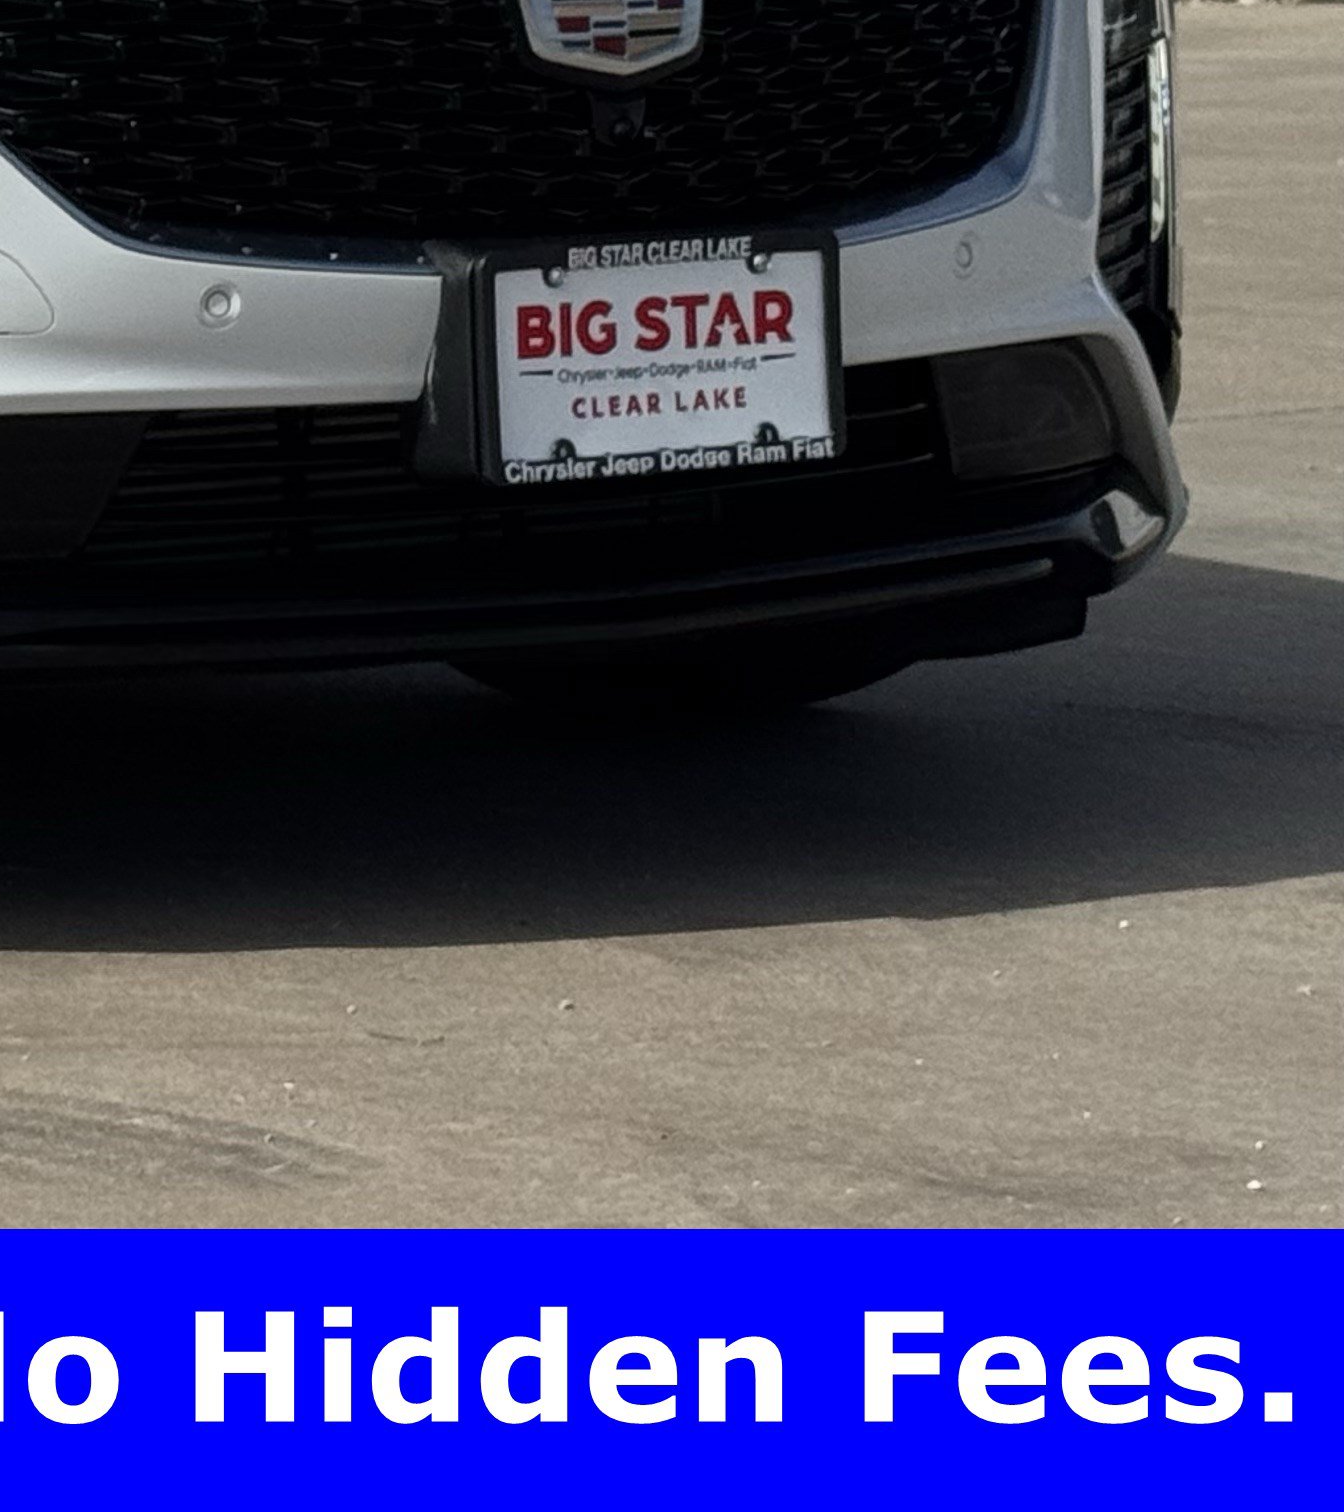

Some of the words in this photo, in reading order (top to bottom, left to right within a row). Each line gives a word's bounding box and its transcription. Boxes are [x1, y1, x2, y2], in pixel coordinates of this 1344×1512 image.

[568, 246, 598, 269] BIG
[600, 242, 644, 266] STAR
[647, 239, 705, 264] CLEAR
[707, 235, 753, 259] LAKE
[517, 299, 617, 360] BIG
[635, 290, 794, 351] STAR
[572, 389, 662, 419] CLEAR
[674, 386, 748, 412] LAKE
[505, 457, 597, 485] Chrysler
[601, 451, 654, 478] Jeep
[661, 445, 730, 476] Dodge
[737, 440, 787, 465] Ram
[792, 436, 836, 461] Fiat
